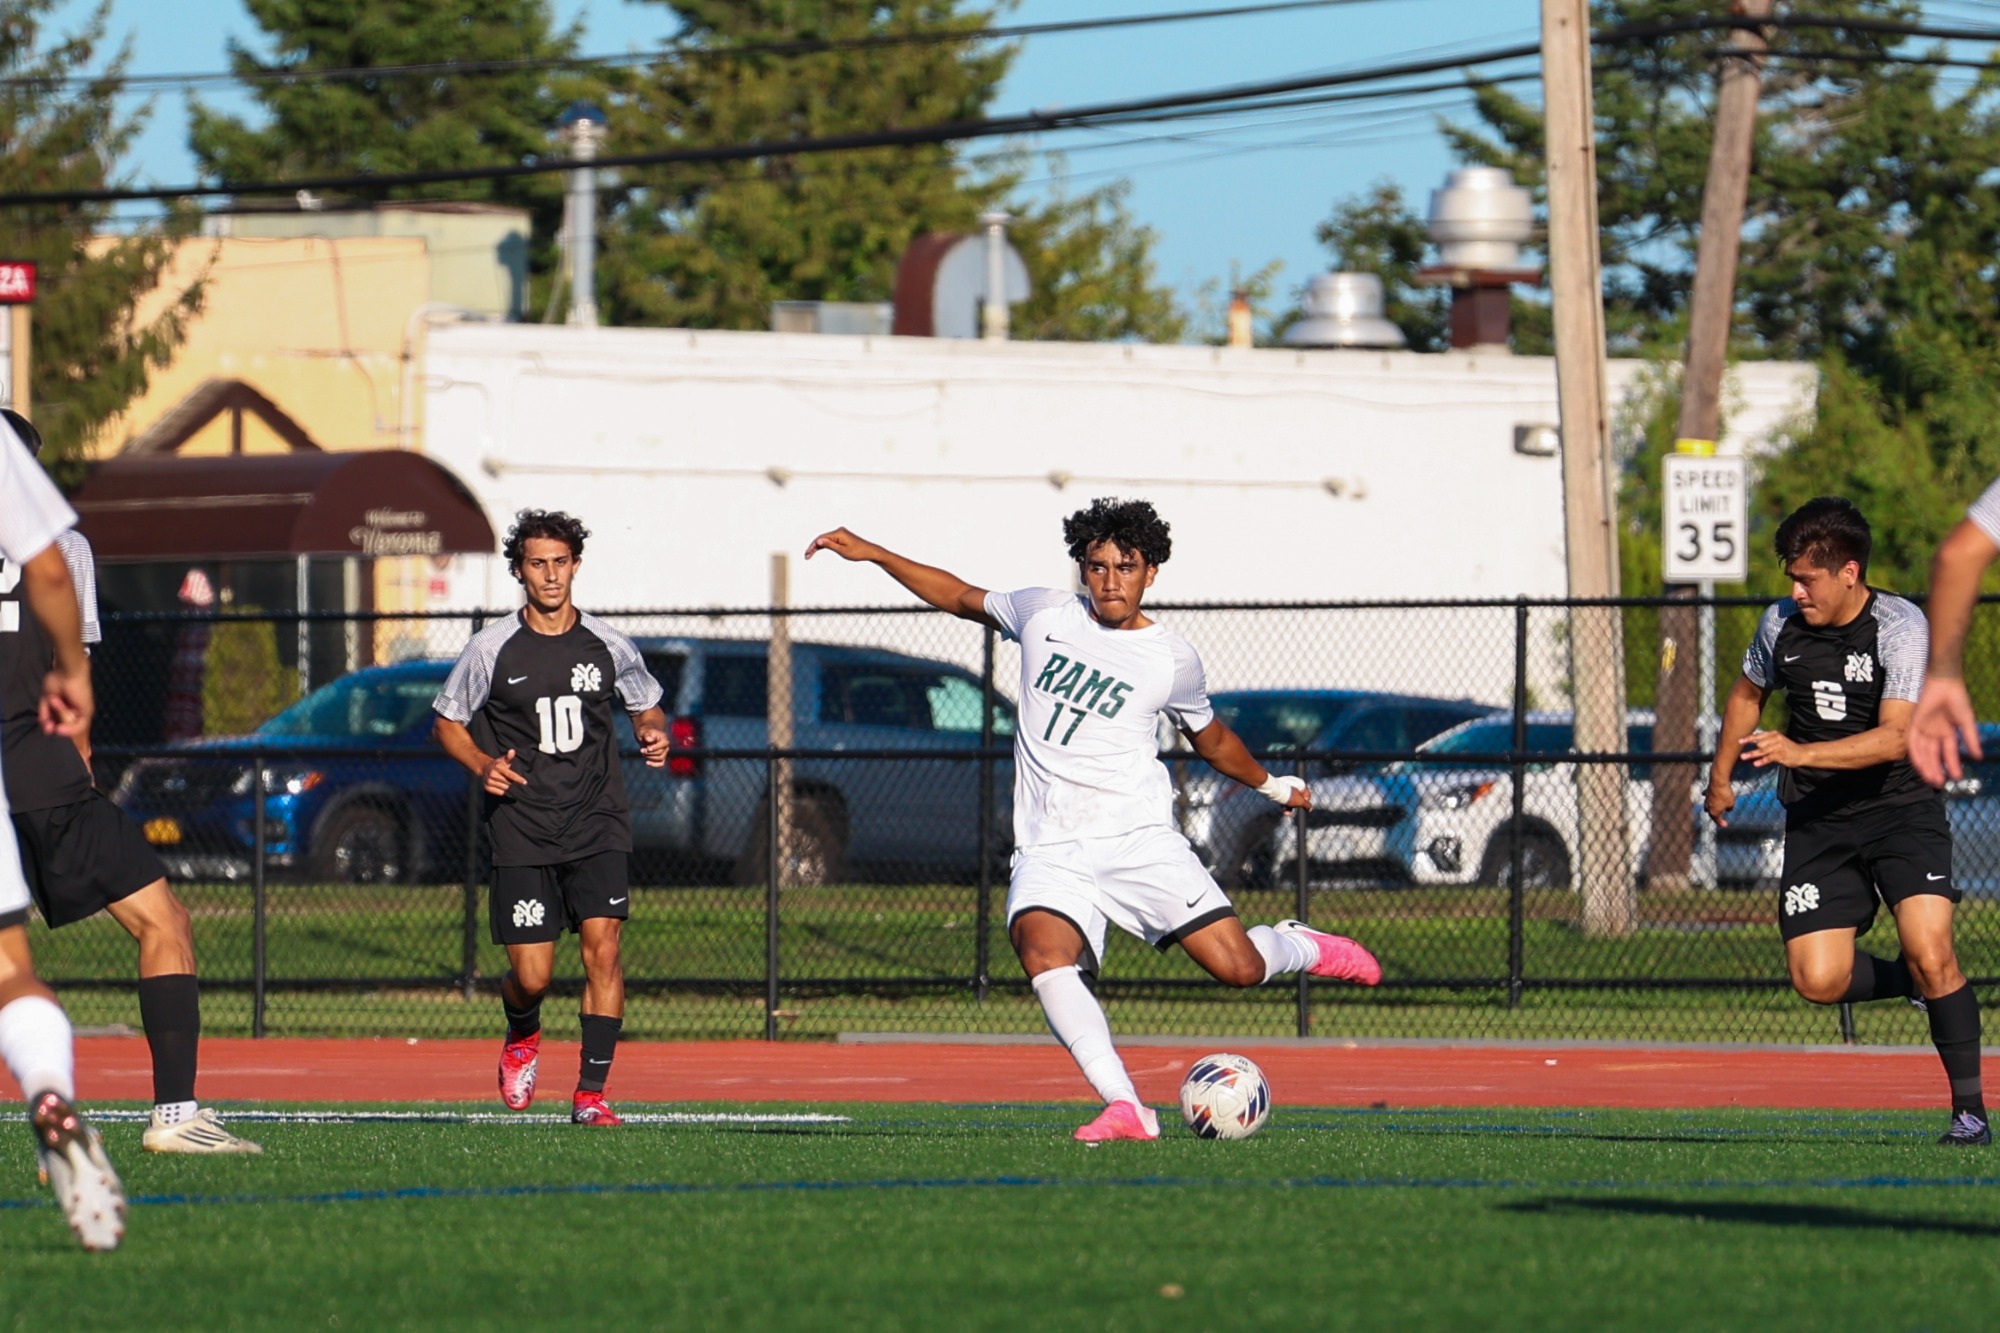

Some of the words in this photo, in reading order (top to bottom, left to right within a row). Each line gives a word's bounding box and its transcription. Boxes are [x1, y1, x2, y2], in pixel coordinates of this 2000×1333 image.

[1674, 471, 1736, 489] SPEED
[1680, 496, 1730, 514] LIMIT
[1677, 522, 1735, 562] 35
[1034, 652, 1134, 719] RAMS
[535, 694, 584, 754] 10
[1043, 702, 1087, 746] 17
